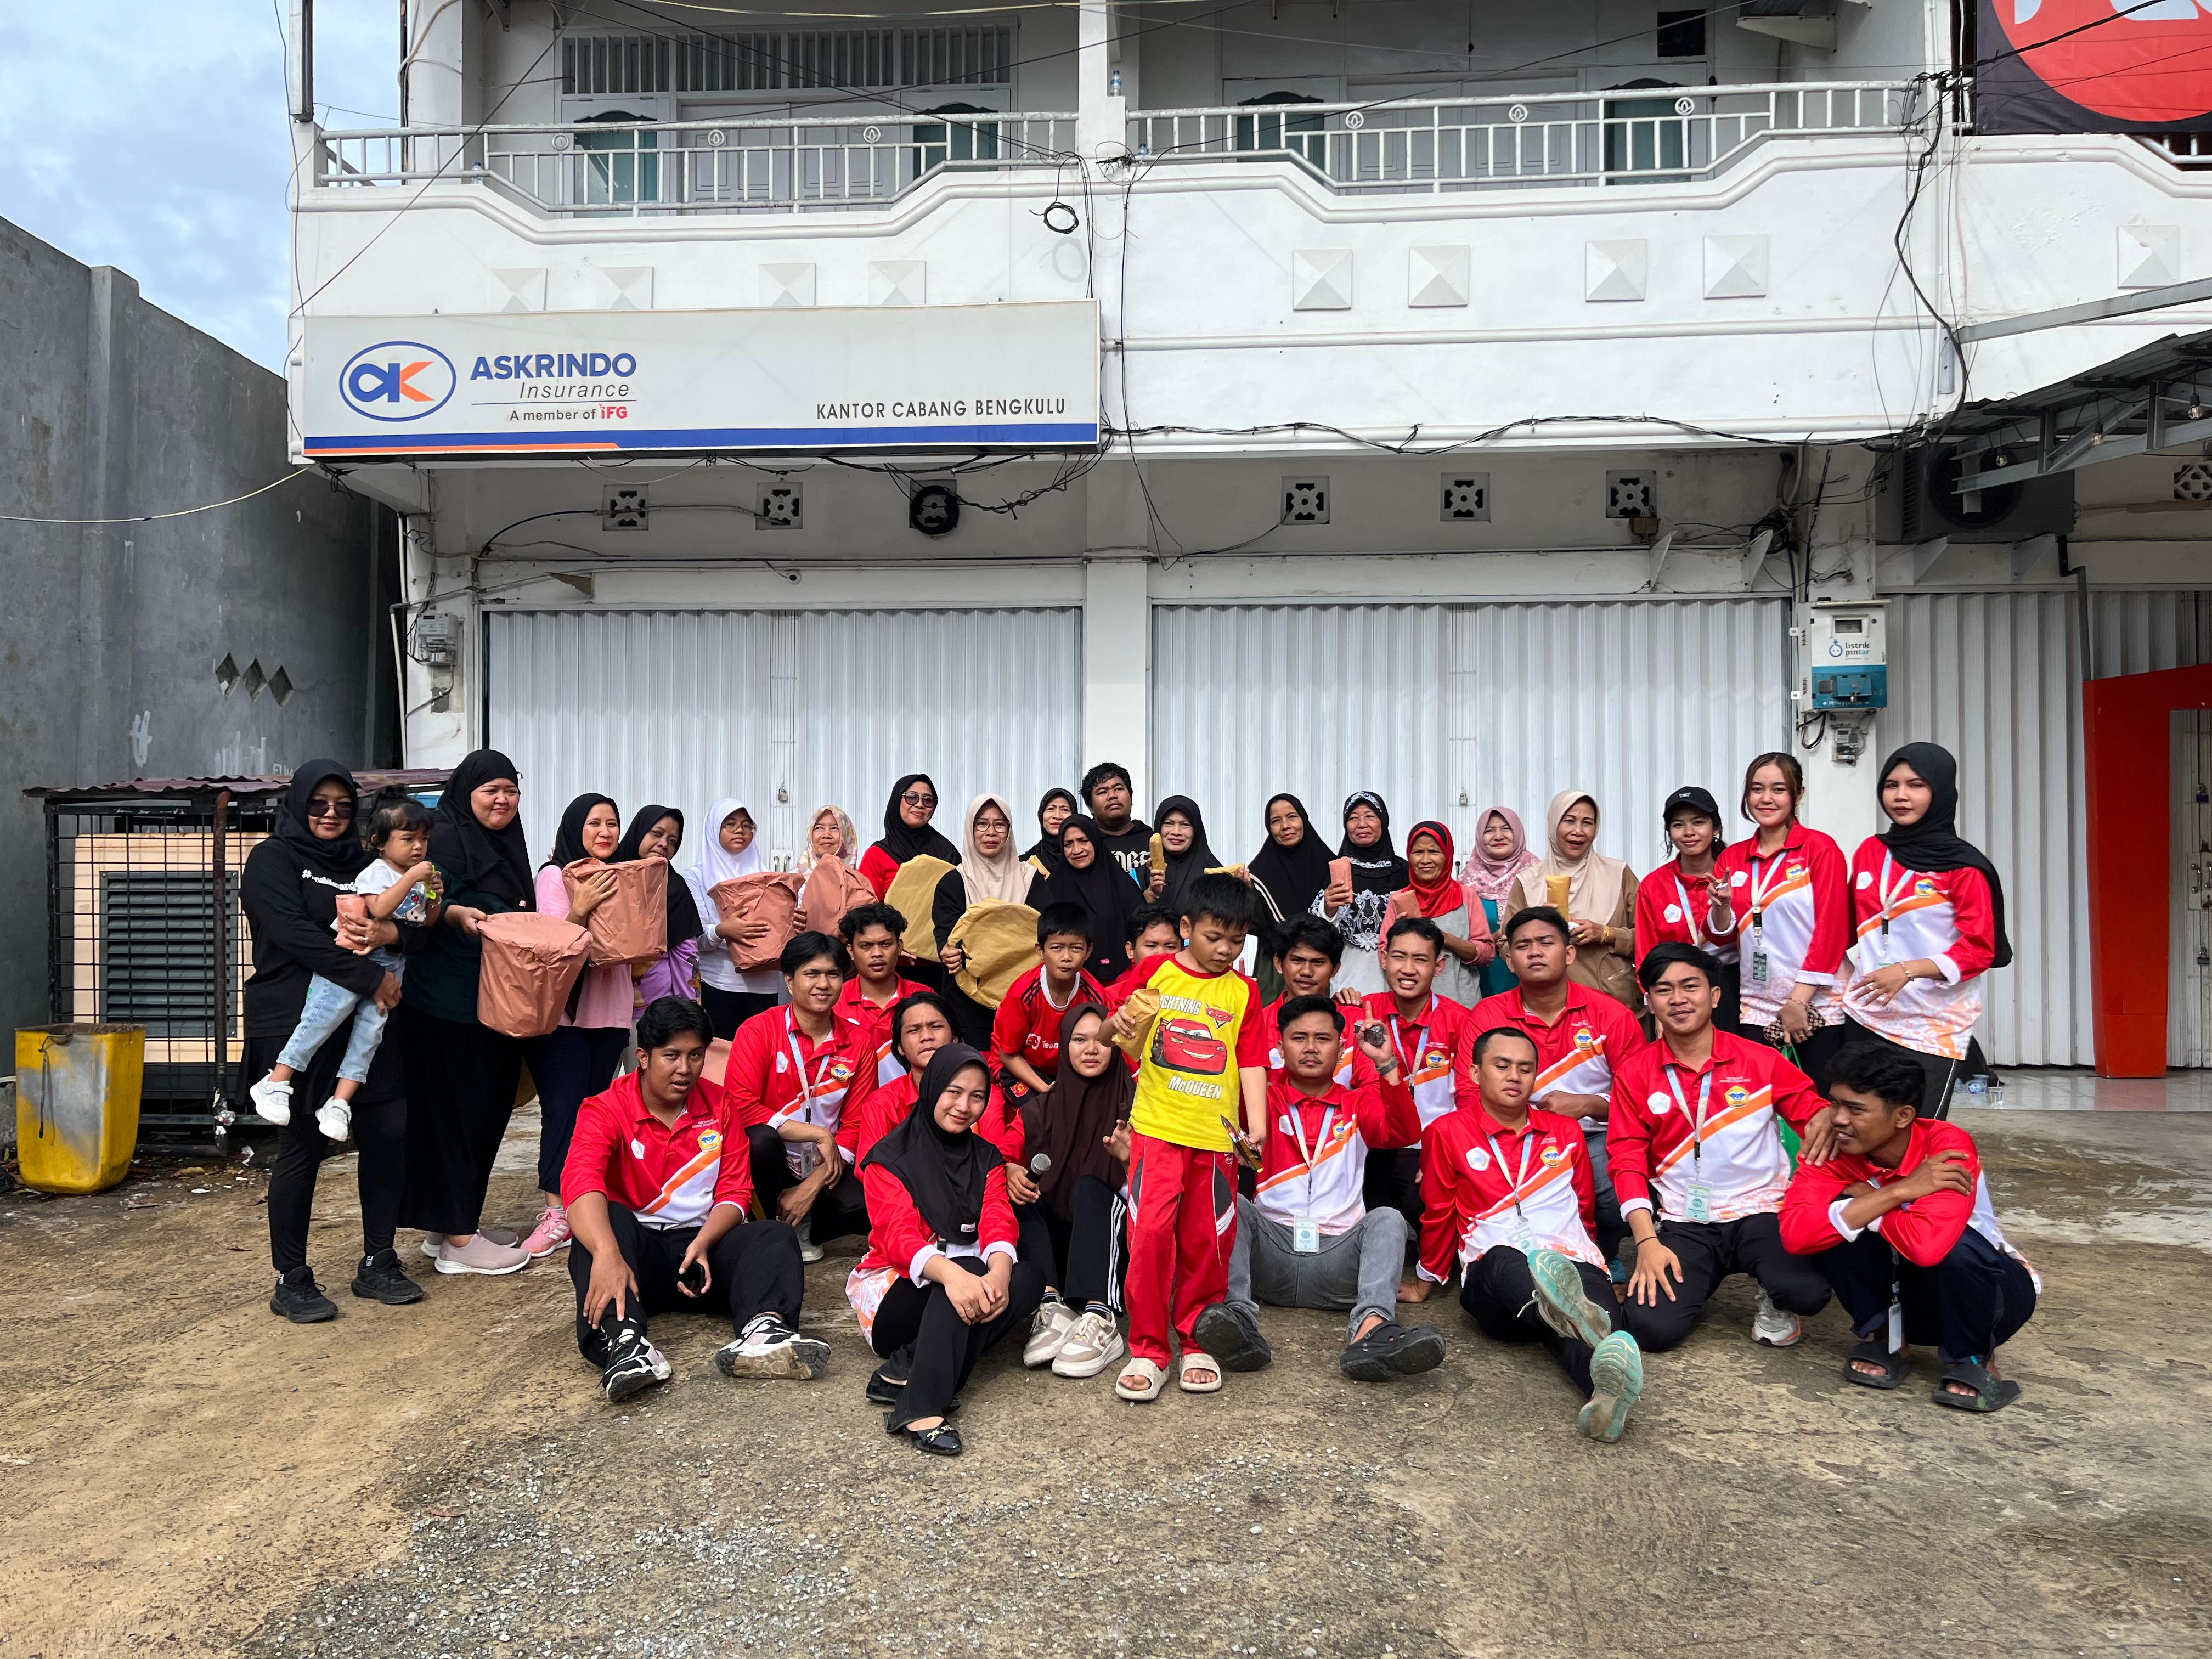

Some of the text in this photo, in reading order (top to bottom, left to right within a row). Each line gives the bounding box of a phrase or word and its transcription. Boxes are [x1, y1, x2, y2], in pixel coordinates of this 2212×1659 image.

[470, 353, 636, 381] ASKRINDO
[520, 382, 629, 399] Insurance
[510, 410, 519, 421] A
[523, 409, 578, 421] member
[582, 408, 596, 420] of
[816, 399, 1065, 419] KANTOR CABANG BENGKULU
[1160, 995, 1202, 1016] IGHTNING
[1167, 1076, 1223, 1100] McQUEEN
